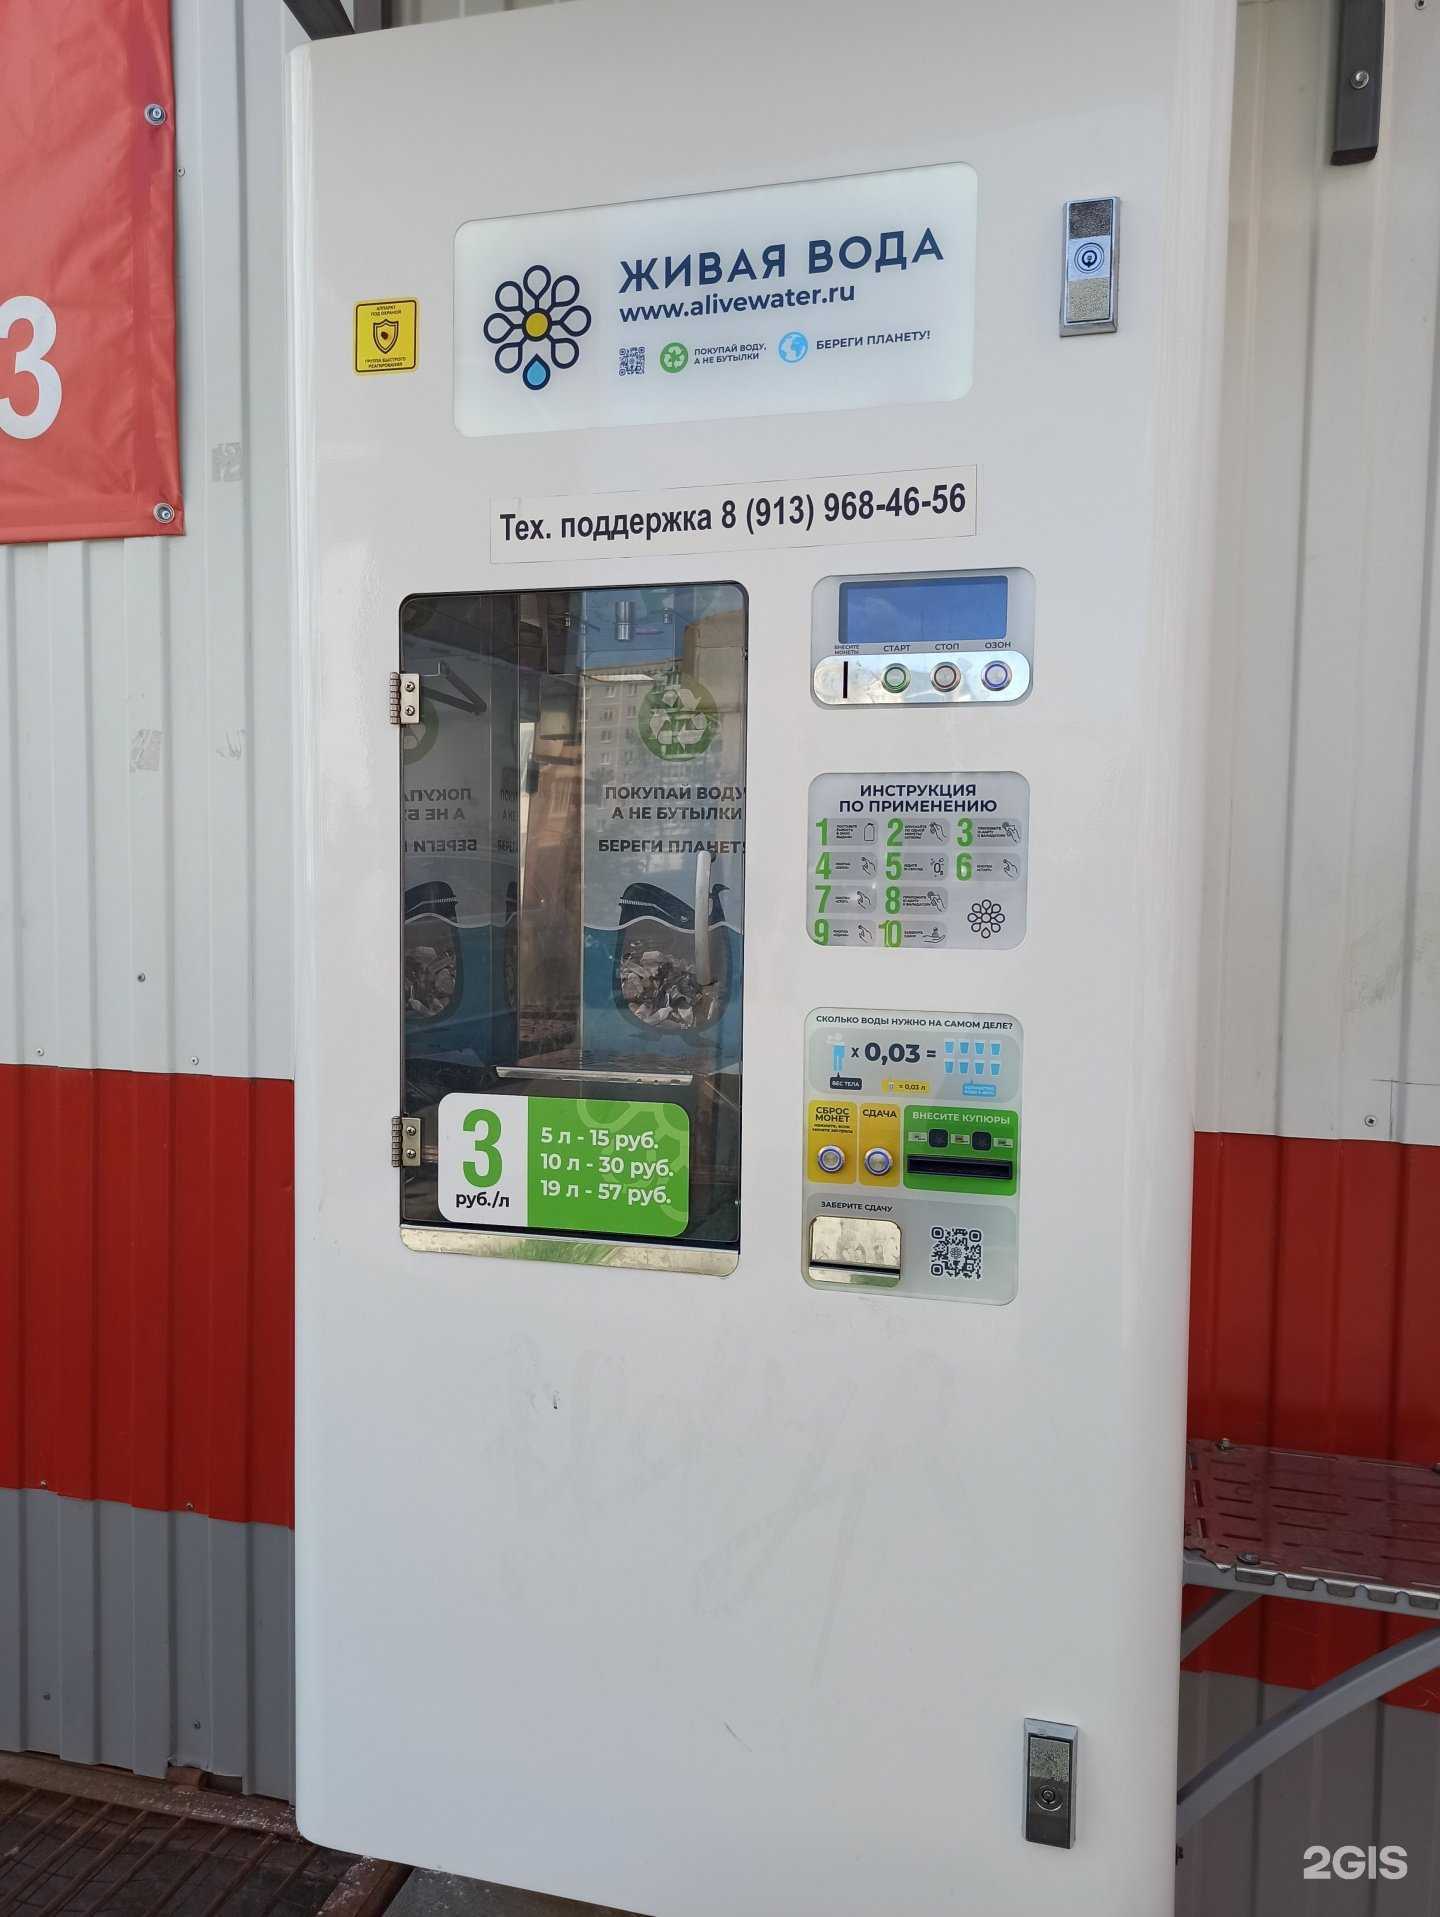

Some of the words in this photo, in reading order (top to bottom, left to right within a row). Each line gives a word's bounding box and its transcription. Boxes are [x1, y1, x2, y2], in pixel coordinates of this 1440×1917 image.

[618, 243, 787, 294] ЖИВАЯ
[808, 227, 944, 274] ВОДА
[619, 285, 855, 323] www.alivewater.ru
[695, 345, 738, 357] ПОКУПАЙ
[740, 343, 767, 353] ВОДУ,
[816, 335, 863, 350] БЕРЕГИ
[866, 329, 931, 346] ПЛАНЕТУ!
[0, 295, 62, 440] 3
[703, 356, 714, 364] НЕ
[716, 353, 759, 363] БУТЫЛКИ
[500, 513, 552, 541] Тех.
[561, 508, 712, 541] поддержка
[722, 500, 736, 528] 8
[746, 494, 814, 534] (913)
[824, 483, 966, 522] 968-46-56
[935, 643, 960, 651] СТОП
[984, 641, 1012, 649] ОЗОН
[605, 784, 691, 800] ПОКУПАЙ
[860, 784, 976, 798] ИНСТРУКЦИЯ
[612, 807, 624, 819] А
[629, 807, 651, 819] НЕ
[656, 807, 742, 820] БУТЫЛКИ
[839, 800, 864, 813] ПО
[869, 800, 997, 813] ПРИМЕНЕНИЮ
[816, 818, 828, 846] 1
[887, 818, 903, 846] 2
[957, 818, 973, 846] 3
[599, 840, 663, 853] БЕРЕГИ
[816, 852, 832, 879] 4
[886, 852, 902, 880] 5
[957, 853, 972, 881] 6
[815, 885, 831, 913] 7
[886, 886, 901, 914] 8
[815, 919, 829, 945] 9
[879, 920, 901, 947] 10
[816, 1015, 859, 1024] СКОЛЬКО
[861, 1017, 889, 1026] ВОДЫ
[891, 1018, 926, 1027] НУЖНО
[929, 1019, 942, 1027] НА
[944, 1020, 980, 1028] САМОМ
[982, 1021, 1013, 1030] ДЕЛЕ?
[865, 1042, 921, 1065] 0,03
[815, 1114, 850, 1122] МОНЕТ
[816, 1107, 849, 1115] СБРОС
[863, 1109, 897, 1118] СДАЧА
[912, 1111, 959, 1122] ВНЕСИТЕ
[962, 1114, 1010, 1125] КУПЮРЫ
[463, 1108, 503, 1188] 3
[540, 1127, 553, 1143] 5
[558, 1131, 571, 1144] л
[589, 1129, 609, 1146] 15
[615, 1131, 659, 1150] руб.
[540, 1153, 561, 1169] 10
[567, 1157, 580, 1171] л
[598, 1157, 624, 1174] 30
[630, 1159, 674, 1179] руб.
[456, 1191, 510, 1208] руб./л
[540, 1180, 560, 1196] 19
[566, 1184, 579, 1197] л
[598, 1183, 621, 1200] 57
[628, 1186, 672, 1206] руб.
[821, 1201, 863, 1210] ЗАБЕРИТЕ
[864, 1203, 893, 1213] СДАЧУ
